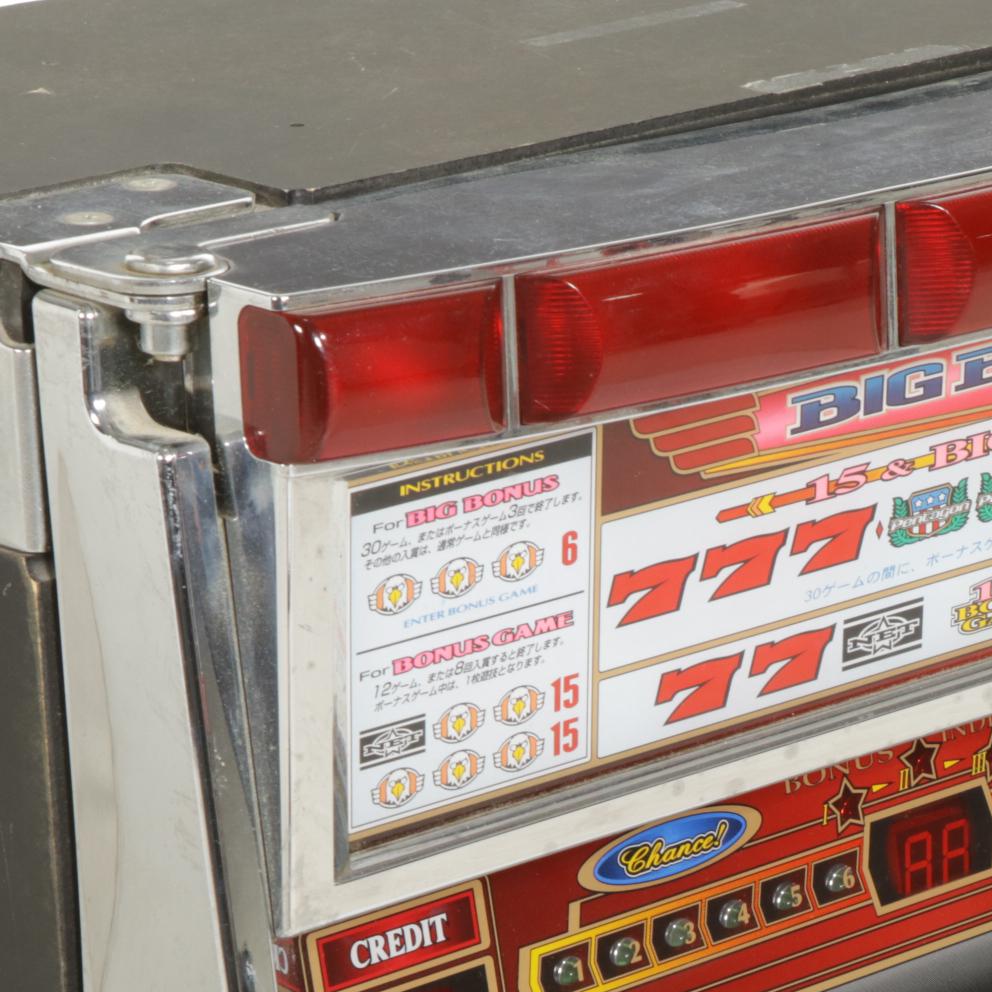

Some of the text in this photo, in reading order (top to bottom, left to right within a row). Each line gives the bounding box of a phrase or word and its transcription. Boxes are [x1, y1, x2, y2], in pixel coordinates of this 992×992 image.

[790, 361, 946, 437] BIG
[400, 450, 545, 497] INSTRUCTIONS
[807, 461, 872, 505] 15
[880, 458, 917, 482] &
[372, 474, 560, 534] For BIG BONUS
[890, 499, 972, 531] Pentagon
[561, 530, 578, 566] 6
[403, 584, 539, 629] ENTER BONUS GAME
[359, 610, 575, 682] For BONUS GAME
[847, 617, 921, 652] NET
[550, 672, 580, 712] 15
[550, 717, 580, 756] 15
[783, 748, 896, 795] BONUS
[619, 821, 727, 876] Chance!
[790, 884, 803, 907] 5
[843, 867, 855, 889] 6
[684, 923, 697, 945] 3
[737, 903, 751, 926] 4
[350, 912, 450, 970] CREDIT
[629, 937, 643, 963] 2
[575, 960, 585, 982] 1
